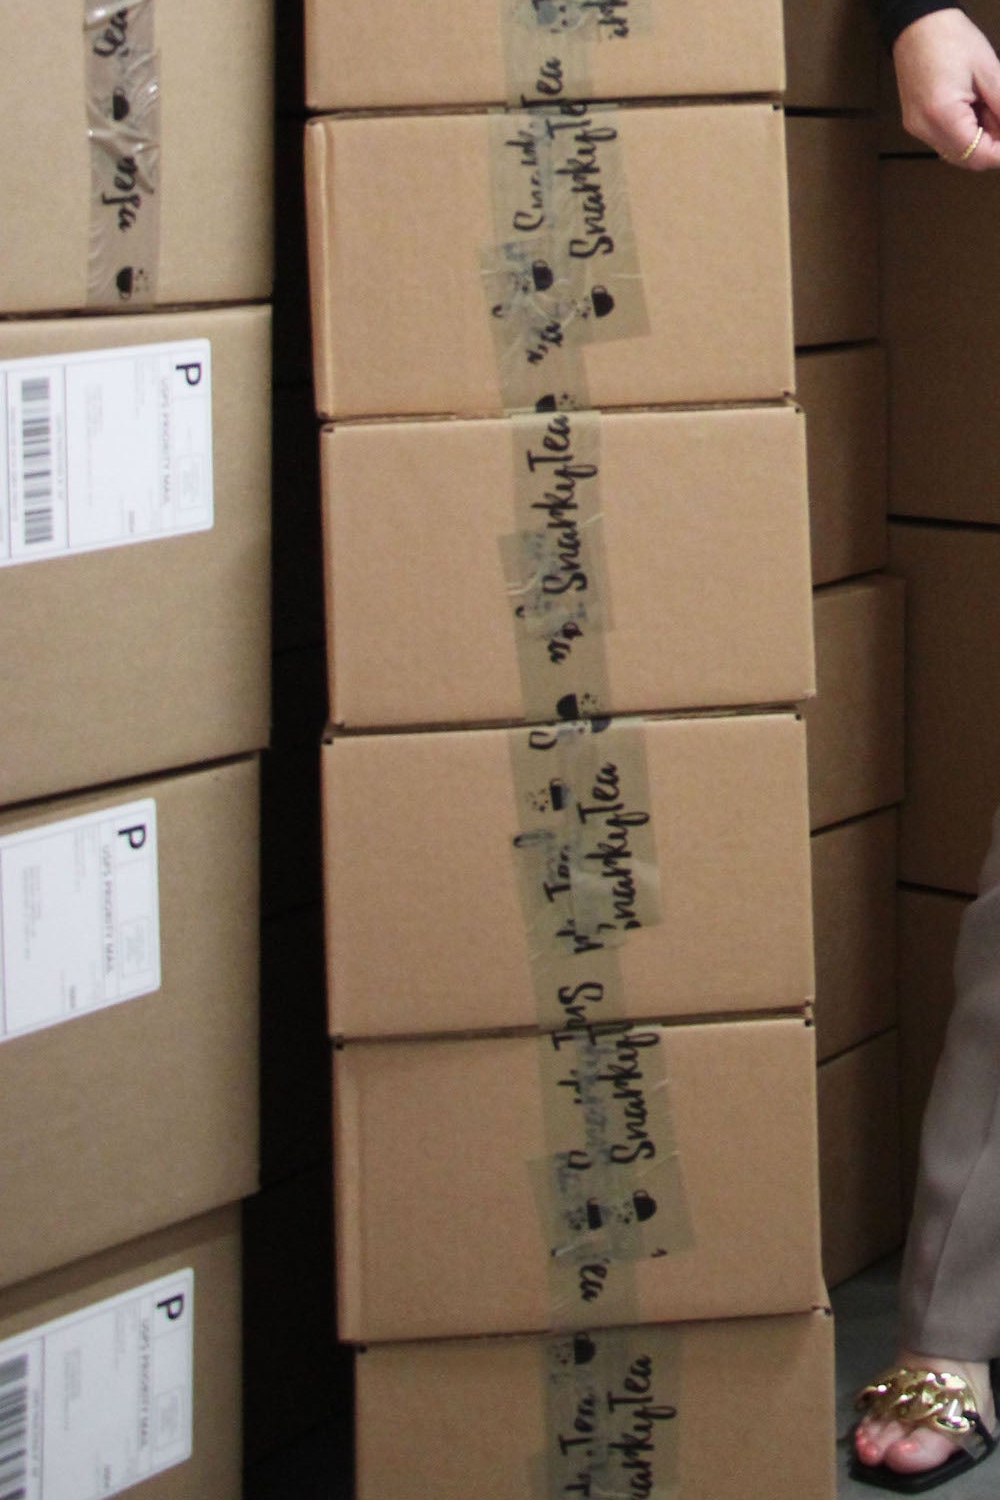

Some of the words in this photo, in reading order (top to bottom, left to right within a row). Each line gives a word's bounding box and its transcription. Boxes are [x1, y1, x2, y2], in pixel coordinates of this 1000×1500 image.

[176, 362, 202, 386] P
[118, 824, 147, 850] P
[156, 1294, 184, 1320] P
